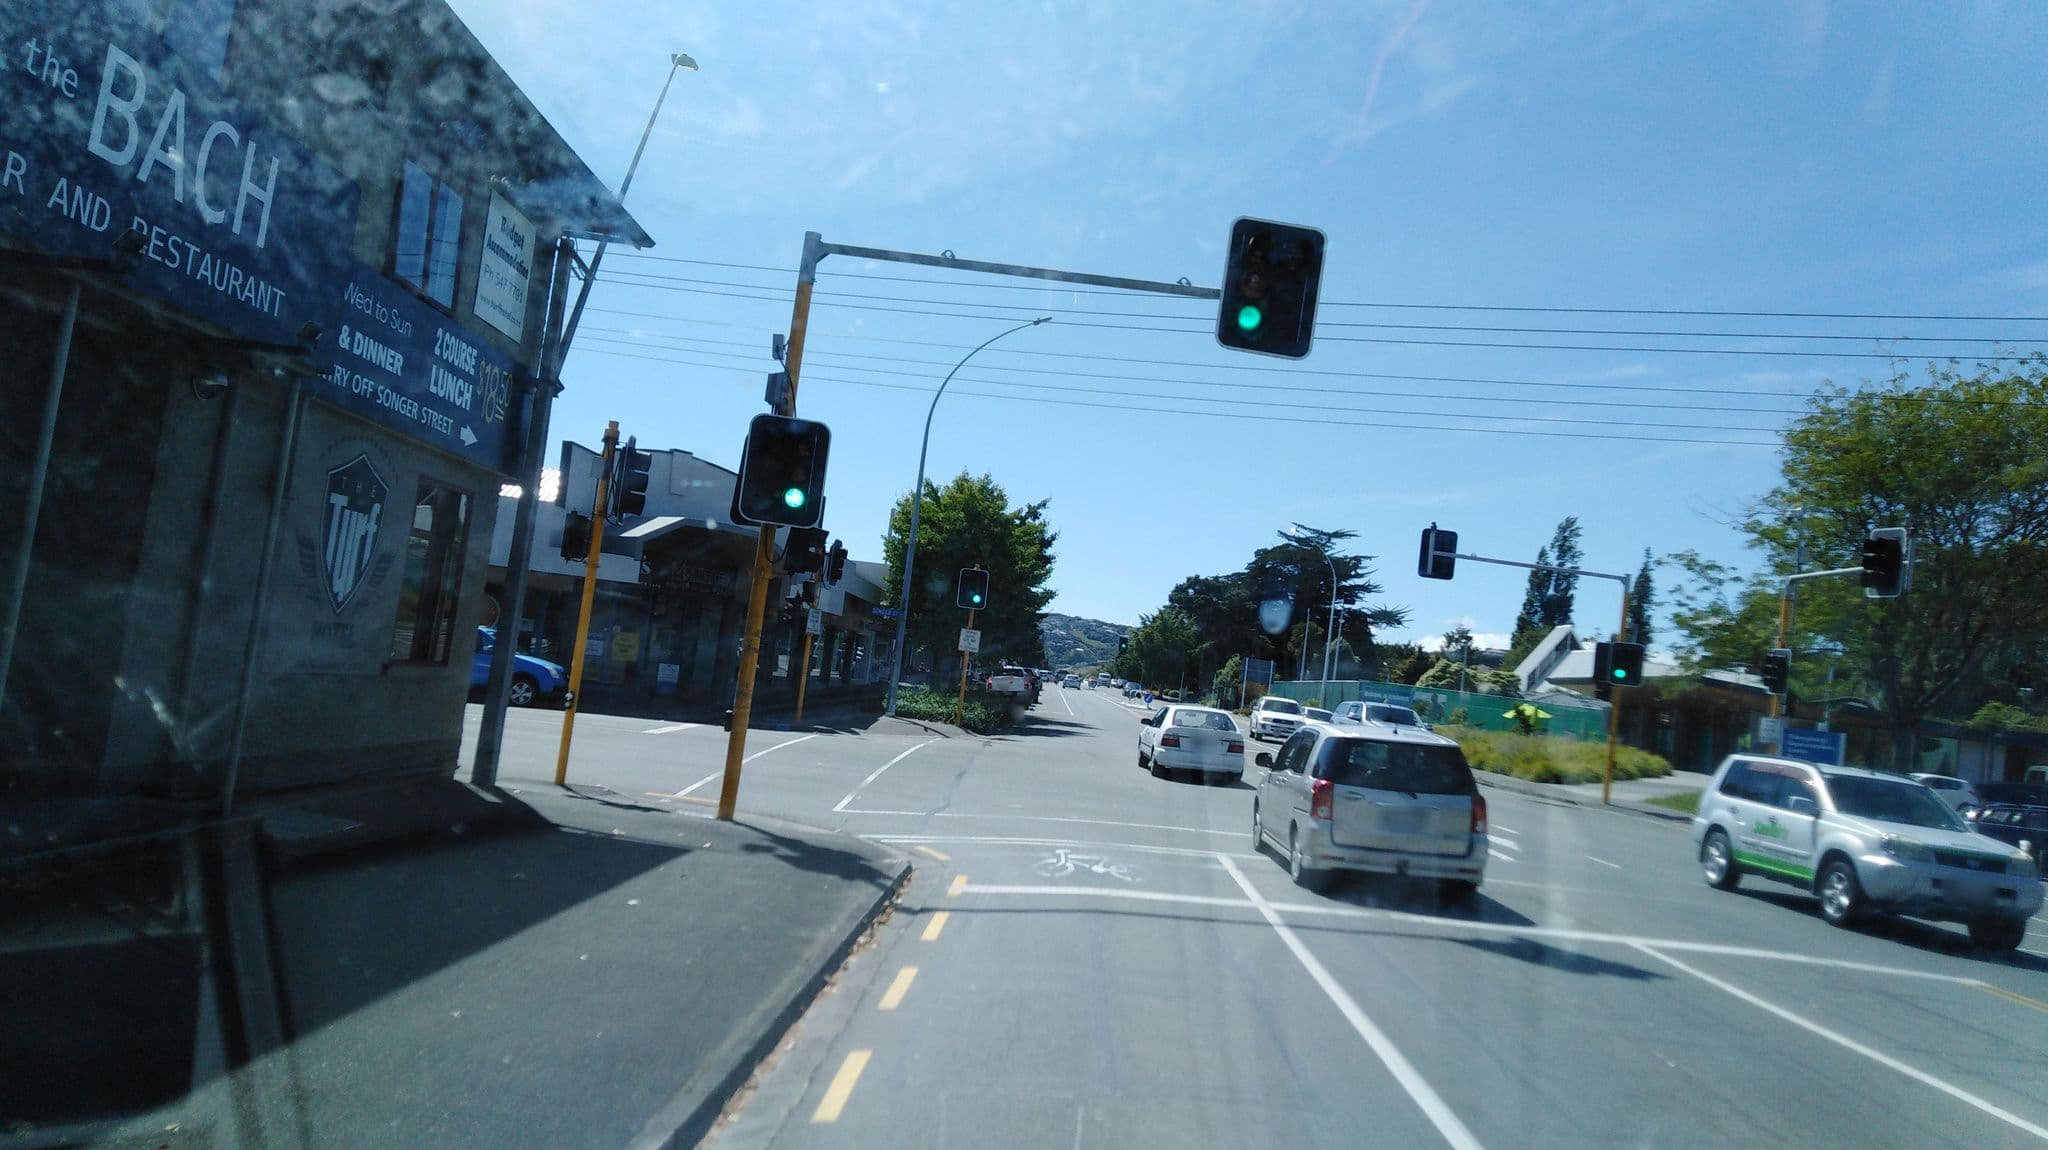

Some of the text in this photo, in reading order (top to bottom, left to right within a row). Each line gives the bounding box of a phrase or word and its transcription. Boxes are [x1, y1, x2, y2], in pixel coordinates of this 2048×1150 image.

[25, 38, 78, 98] the
[87, 42, 279, 249] BACH
[47, 177, 111, 232] AND
[344, 281, 412, 337] Wed to Sun
[338, 324, 351, 351] &
[352, 330, 404, 377] DINNER
[434, 327, 478, 376] 2 COURSE
[351, 374, 375, 399] OFF
[376, 384, 419, 420] SONGER
[421, 406, 454, 436] STREET
[429, 364, 473, 411] LUNCH
[325, 492, 382, 603] Turf
